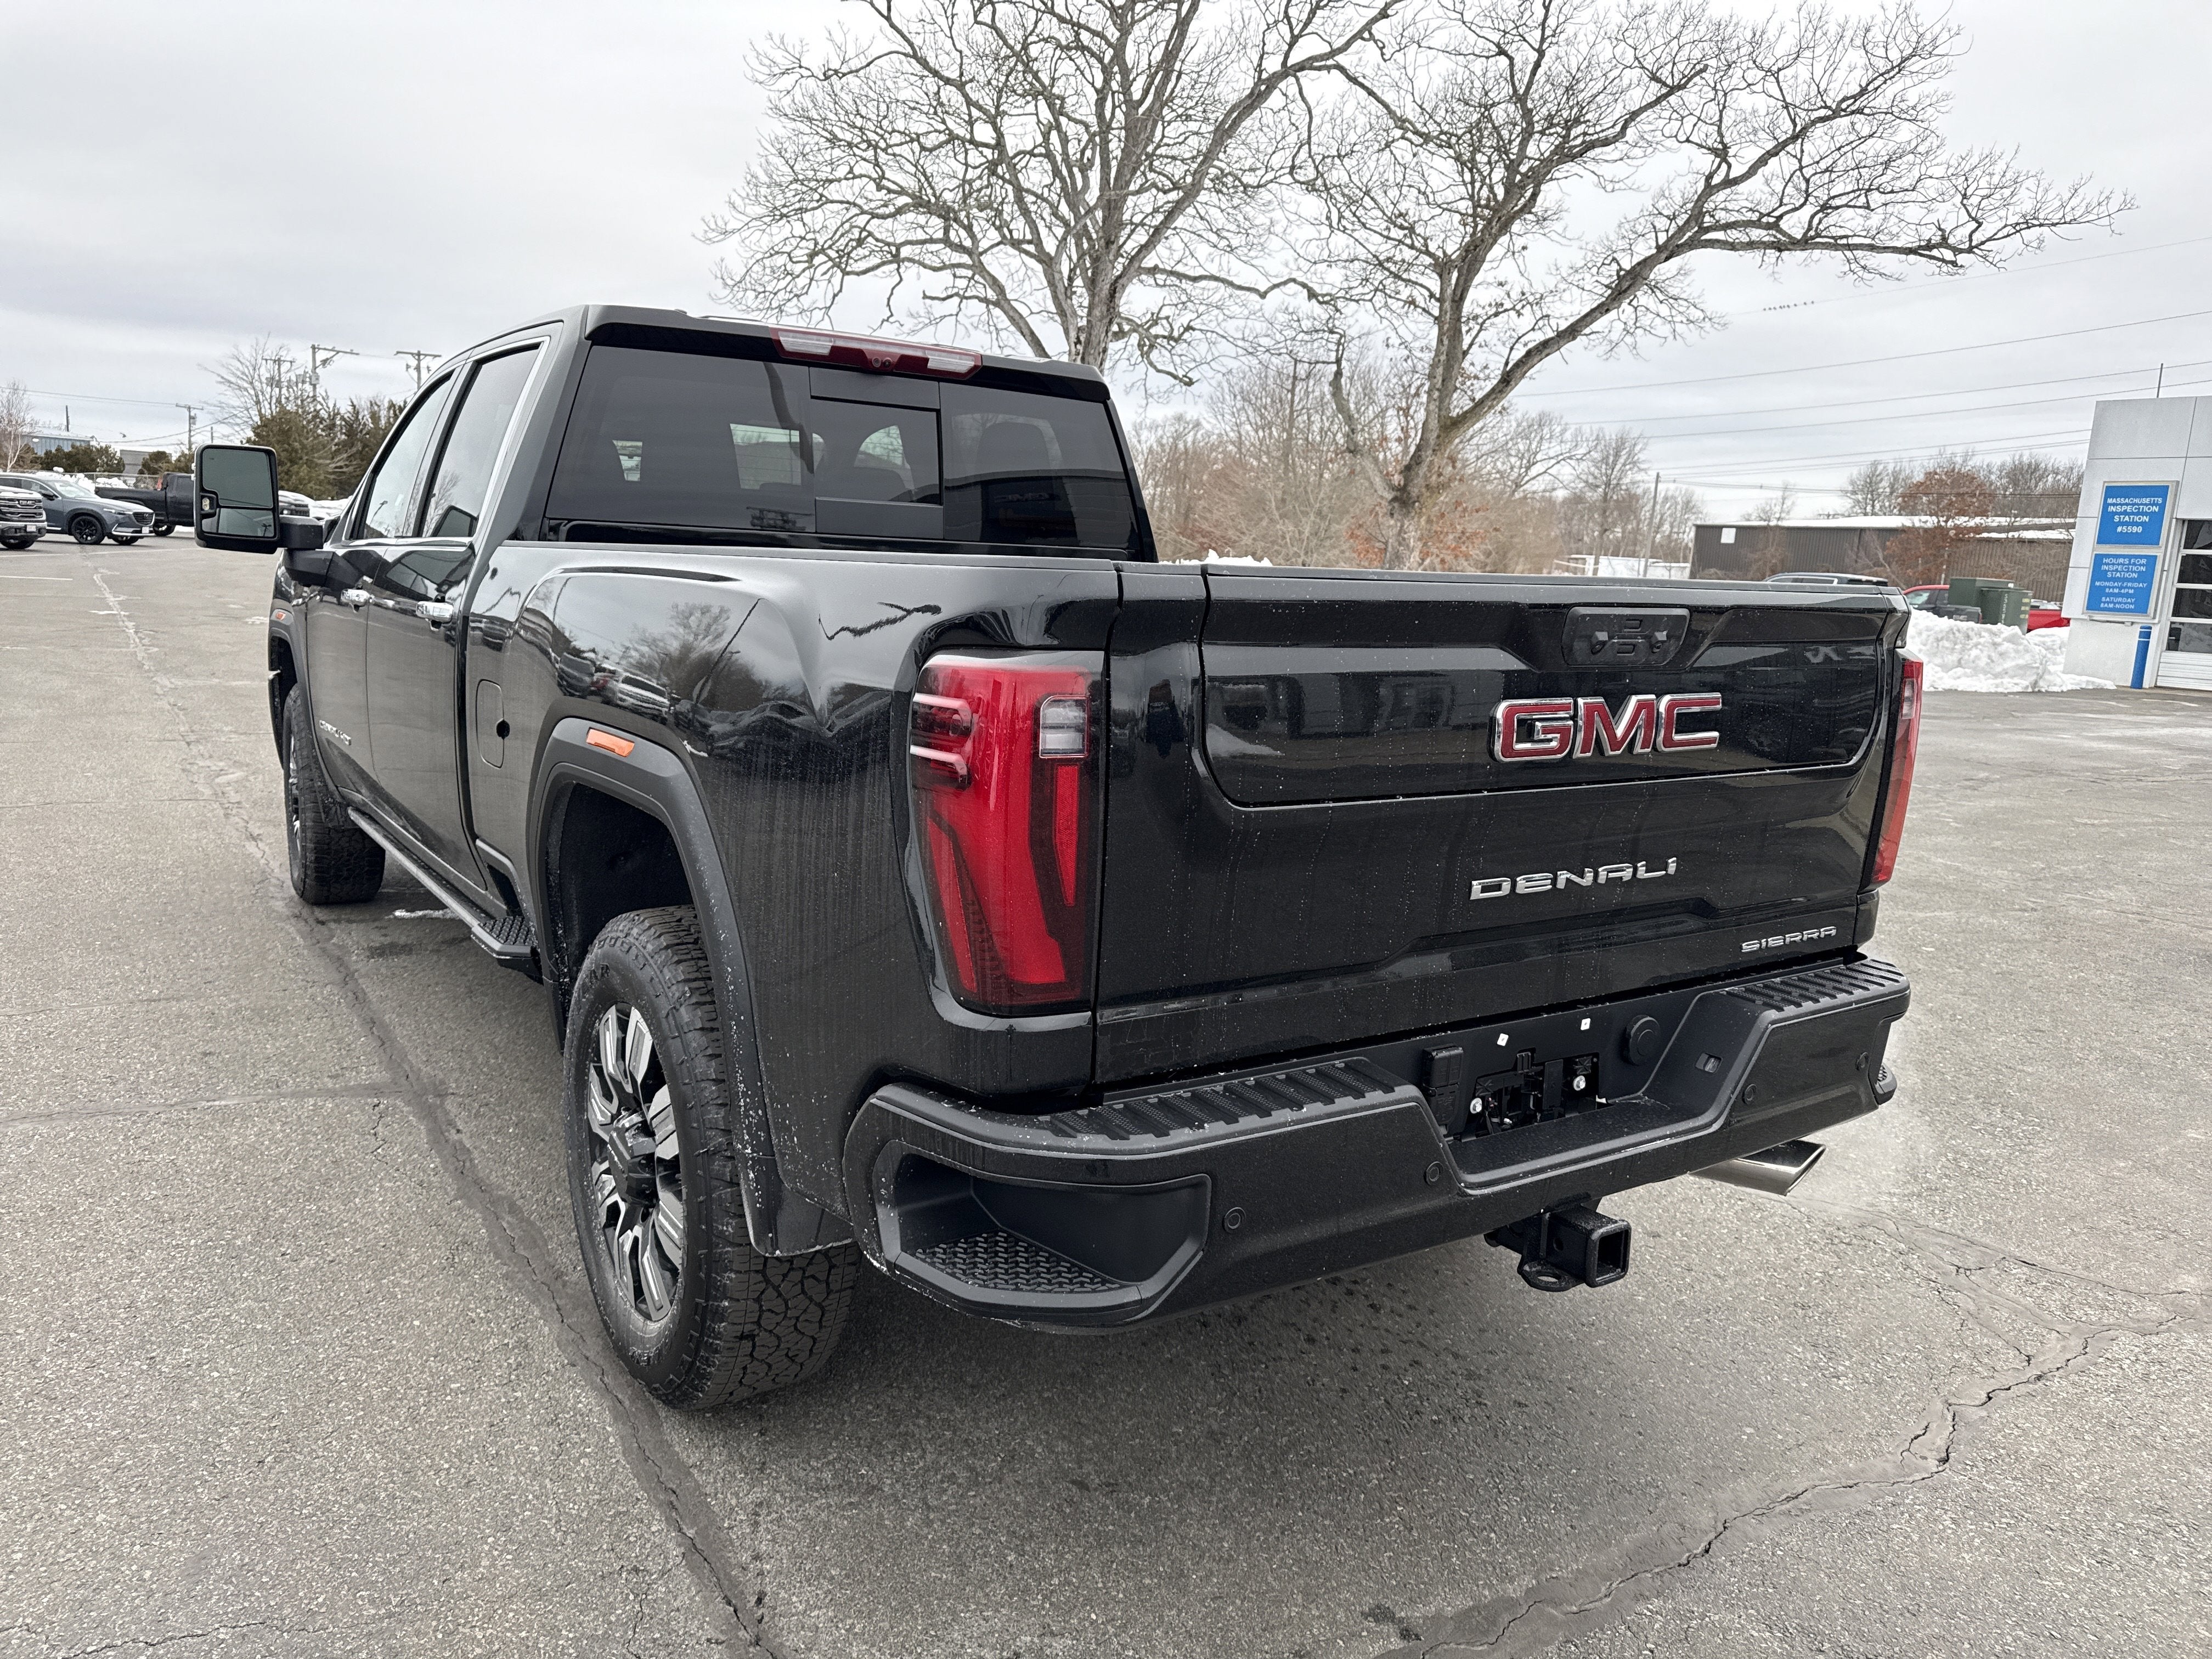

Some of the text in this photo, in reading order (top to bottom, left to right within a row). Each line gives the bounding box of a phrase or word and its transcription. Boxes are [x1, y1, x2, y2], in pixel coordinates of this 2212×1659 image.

[1493, 692, 1723, 763] GMC
[1469, 856, 1677, 900] DENALI
[1741, 926, 1837, 953] SIERRA
